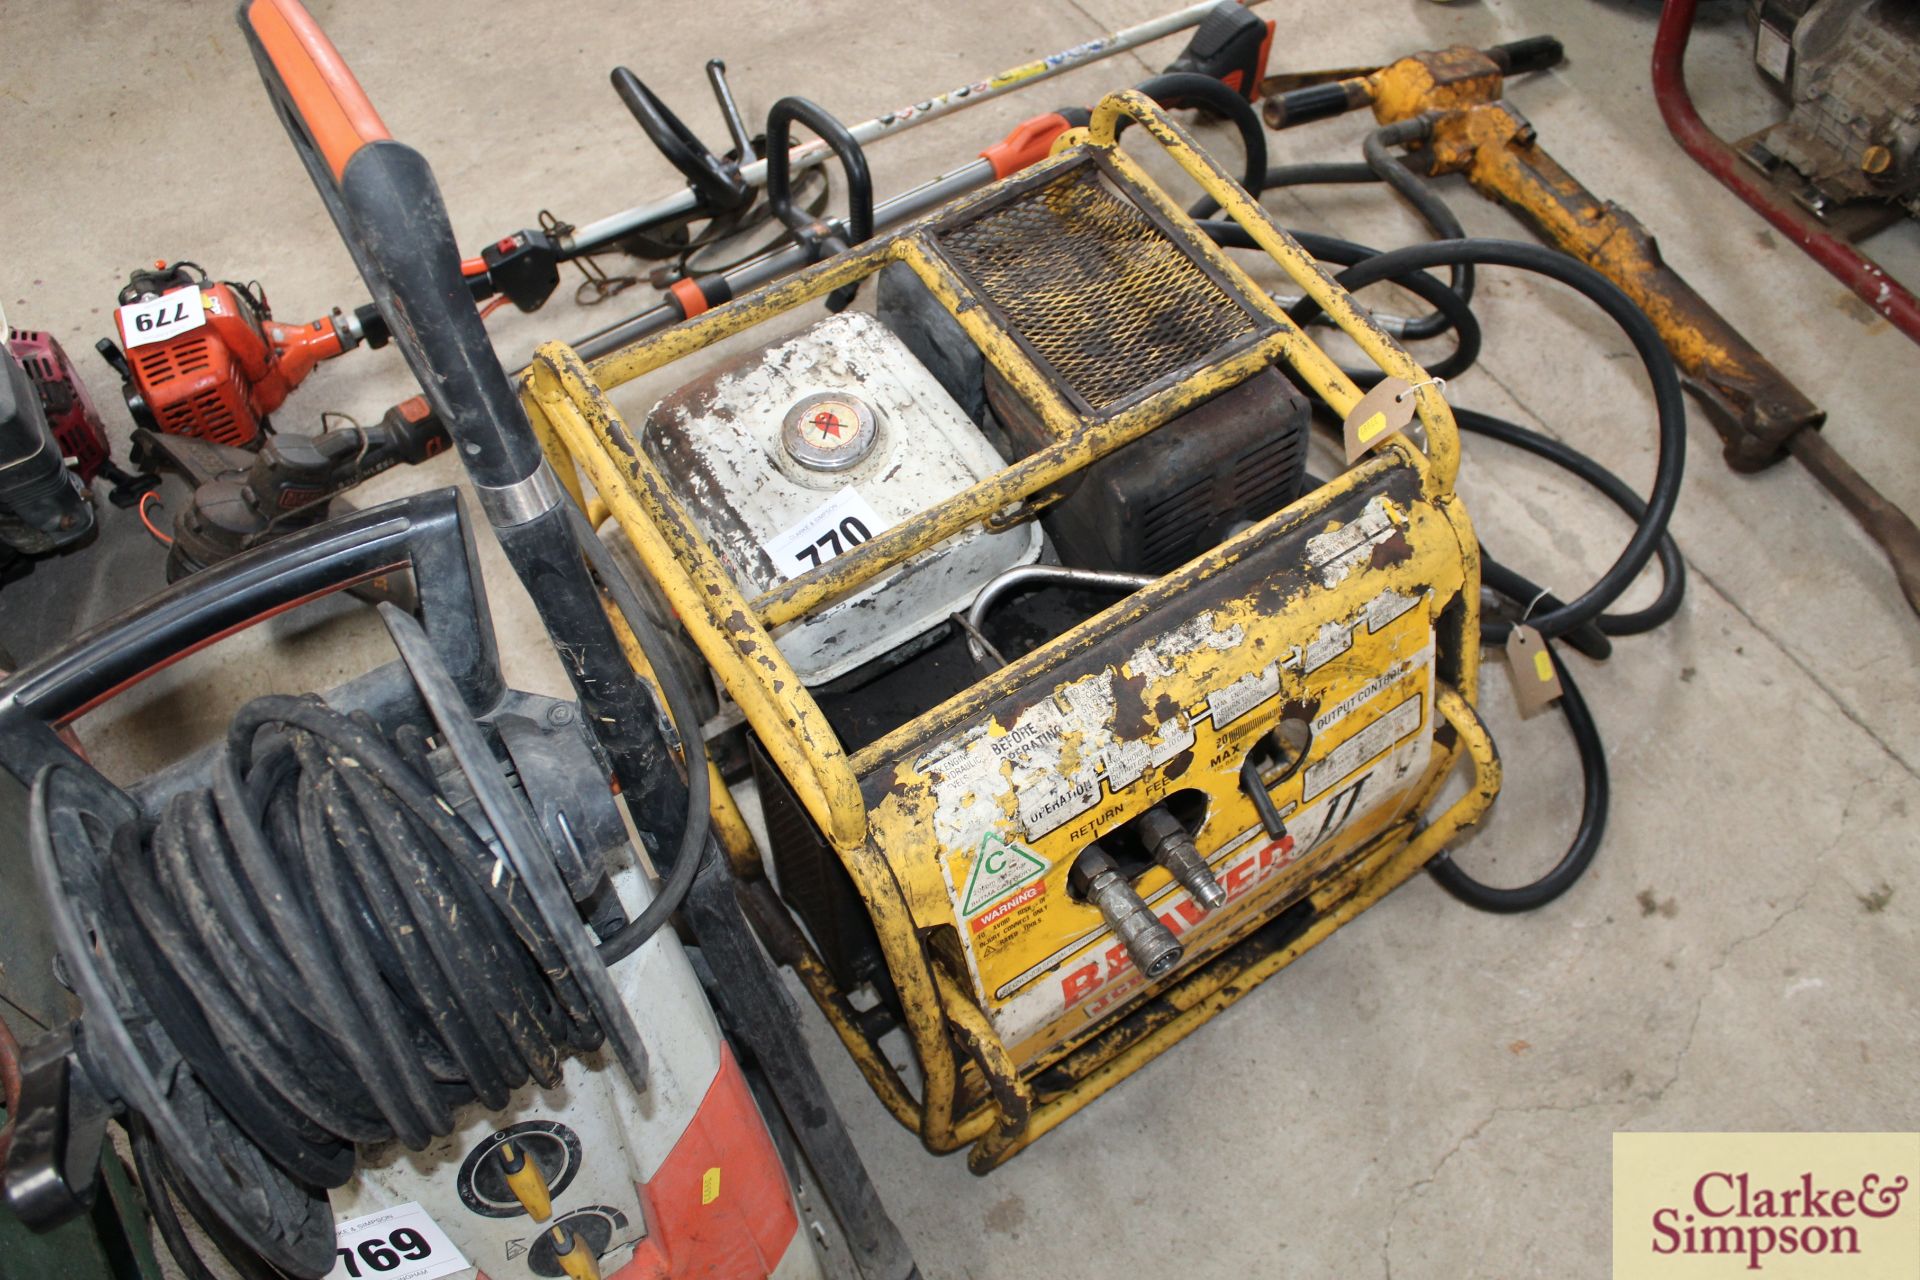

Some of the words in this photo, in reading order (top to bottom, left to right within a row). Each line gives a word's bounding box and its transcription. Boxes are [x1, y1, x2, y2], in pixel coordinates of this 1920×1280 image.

[135, 302, 190, 332] 779
[795, 516, 873, 568] 770
[1317, 697, 1356, 730] OUTPUT
[991, 723, 1037, 754] BEFORE
[945, 756, 982, 780] YDRAULIC
[1210, 744, 1241, 768] MAX
[1146, 777, 1169, 795] FEE
[1070, 803, 1124, 842] RETURN
[985, 850, 1007, 875] C
[980, 887, 1038, 926] WARNING
[1003, 915, 1030, 934] CONNECT
[336, 1228, 432, 1277] 769
